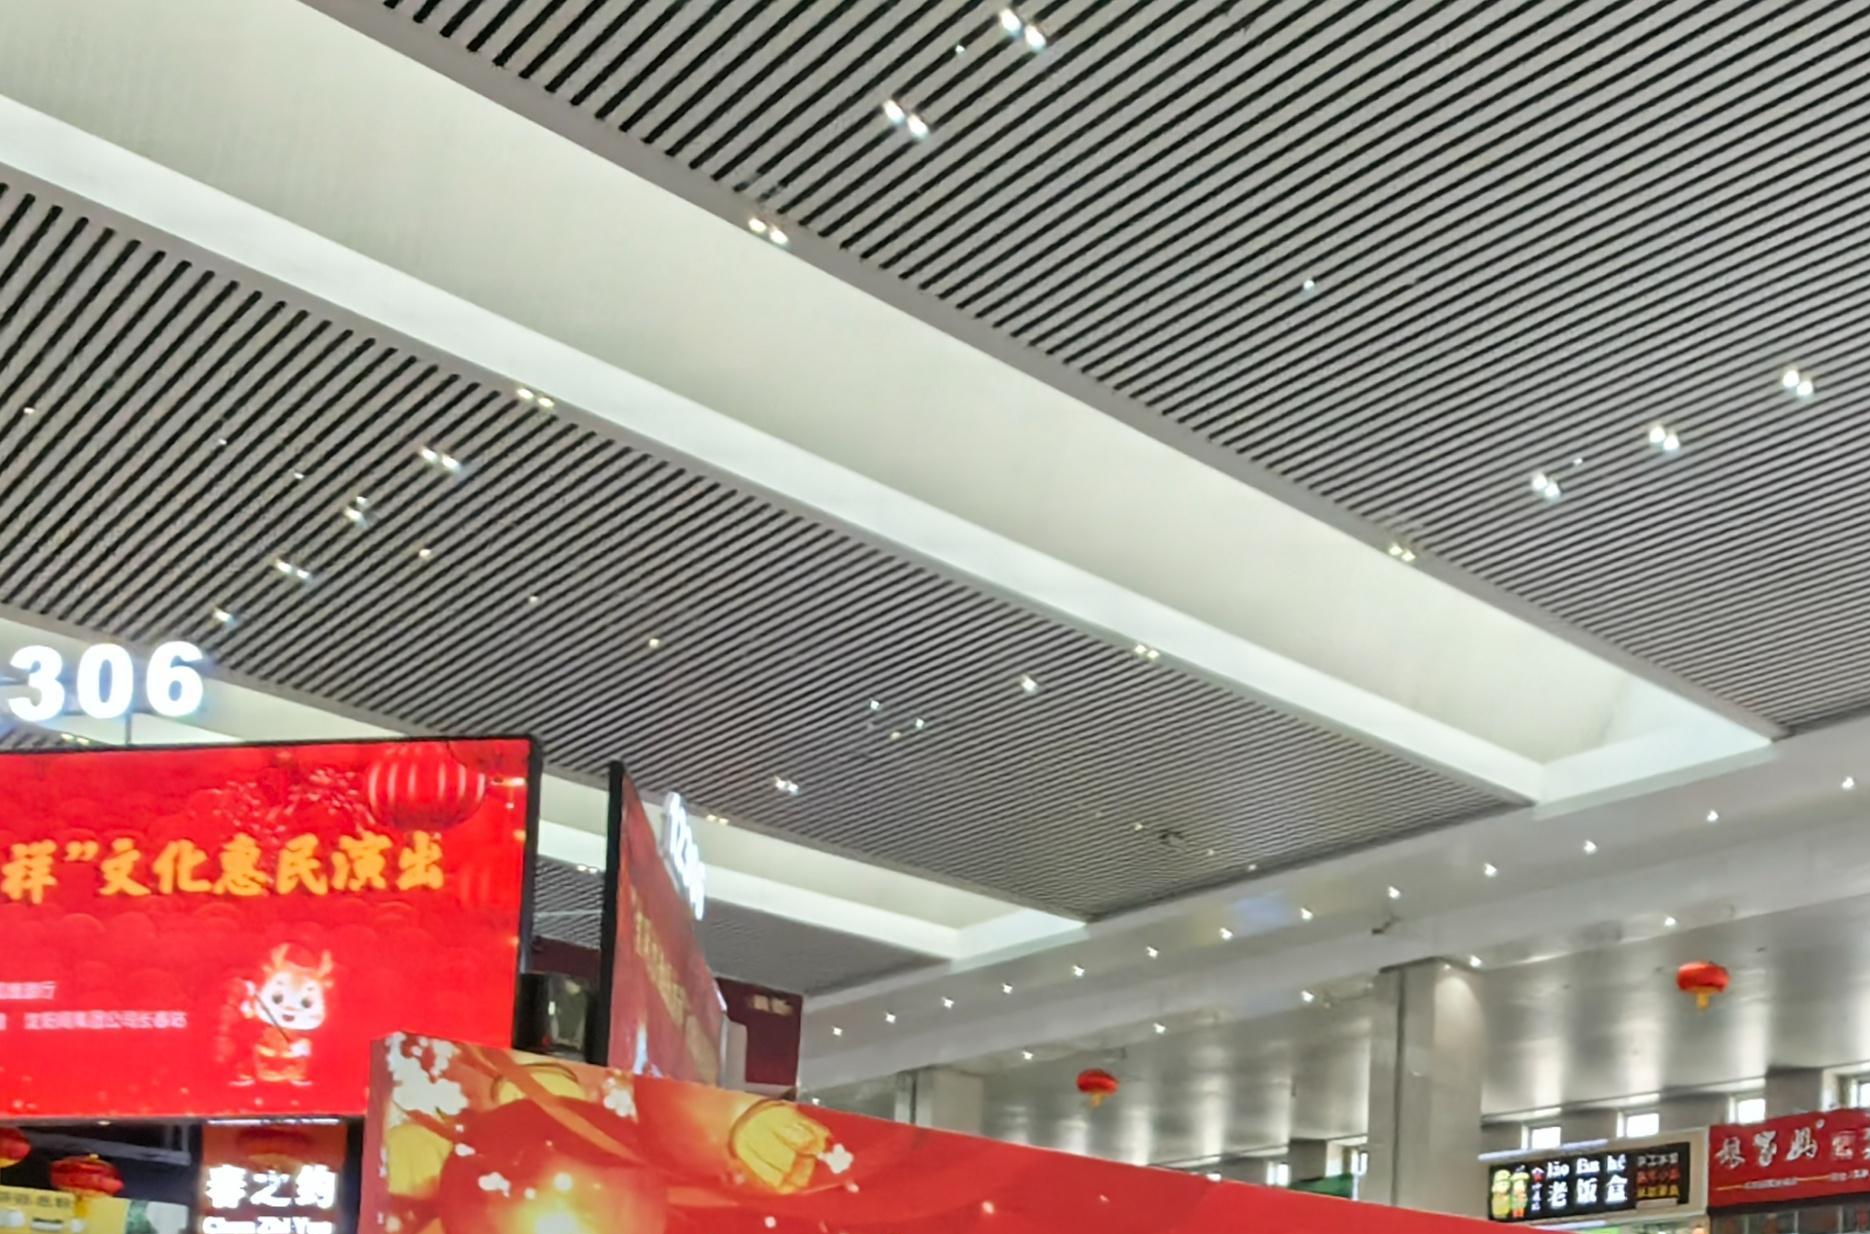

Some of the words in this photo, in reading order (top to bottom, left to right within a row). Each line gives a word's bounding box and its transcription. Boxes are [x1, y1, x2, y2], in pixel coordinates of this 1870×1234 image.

[9, 641, 204, 722] 306
[1547, 1174, 1628, 1210] 老饭盒
